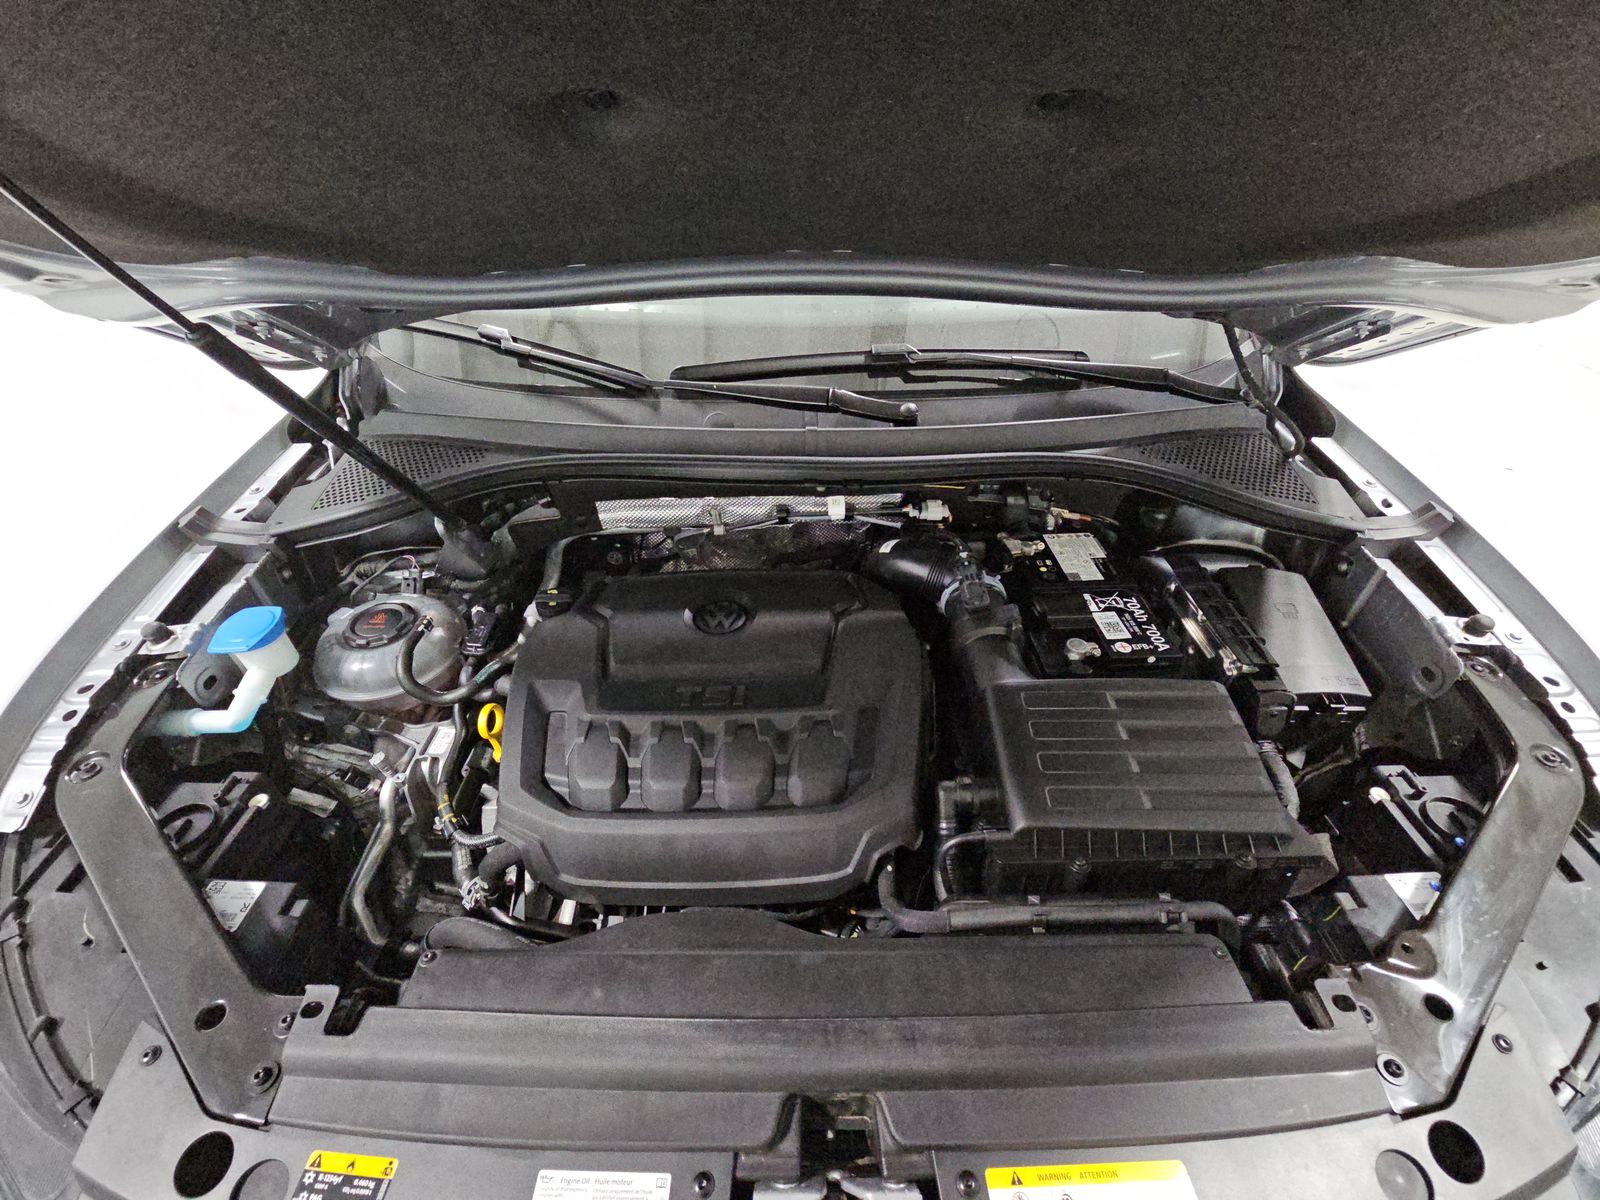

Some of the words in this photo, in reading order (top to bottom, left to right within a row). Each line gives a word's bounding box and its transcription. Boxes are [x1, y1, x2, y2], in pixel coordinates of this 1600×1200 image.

[1123, 597, 1148, 622] 70Ah
[1142, 624, 1170, 652] 700A
[1132, 643, 1154, 651] EFB+
[676, 685, 746, 707] TSI
[560, 1176, 581, 1186] Engine
[581, 1177, 591, 1185] Oil
[594, 1177, 612, 1186] Huile
[1037, 1172, 1072, 1182] WARNING
[1079, 1170, 1119, 1180] ATTENTION
